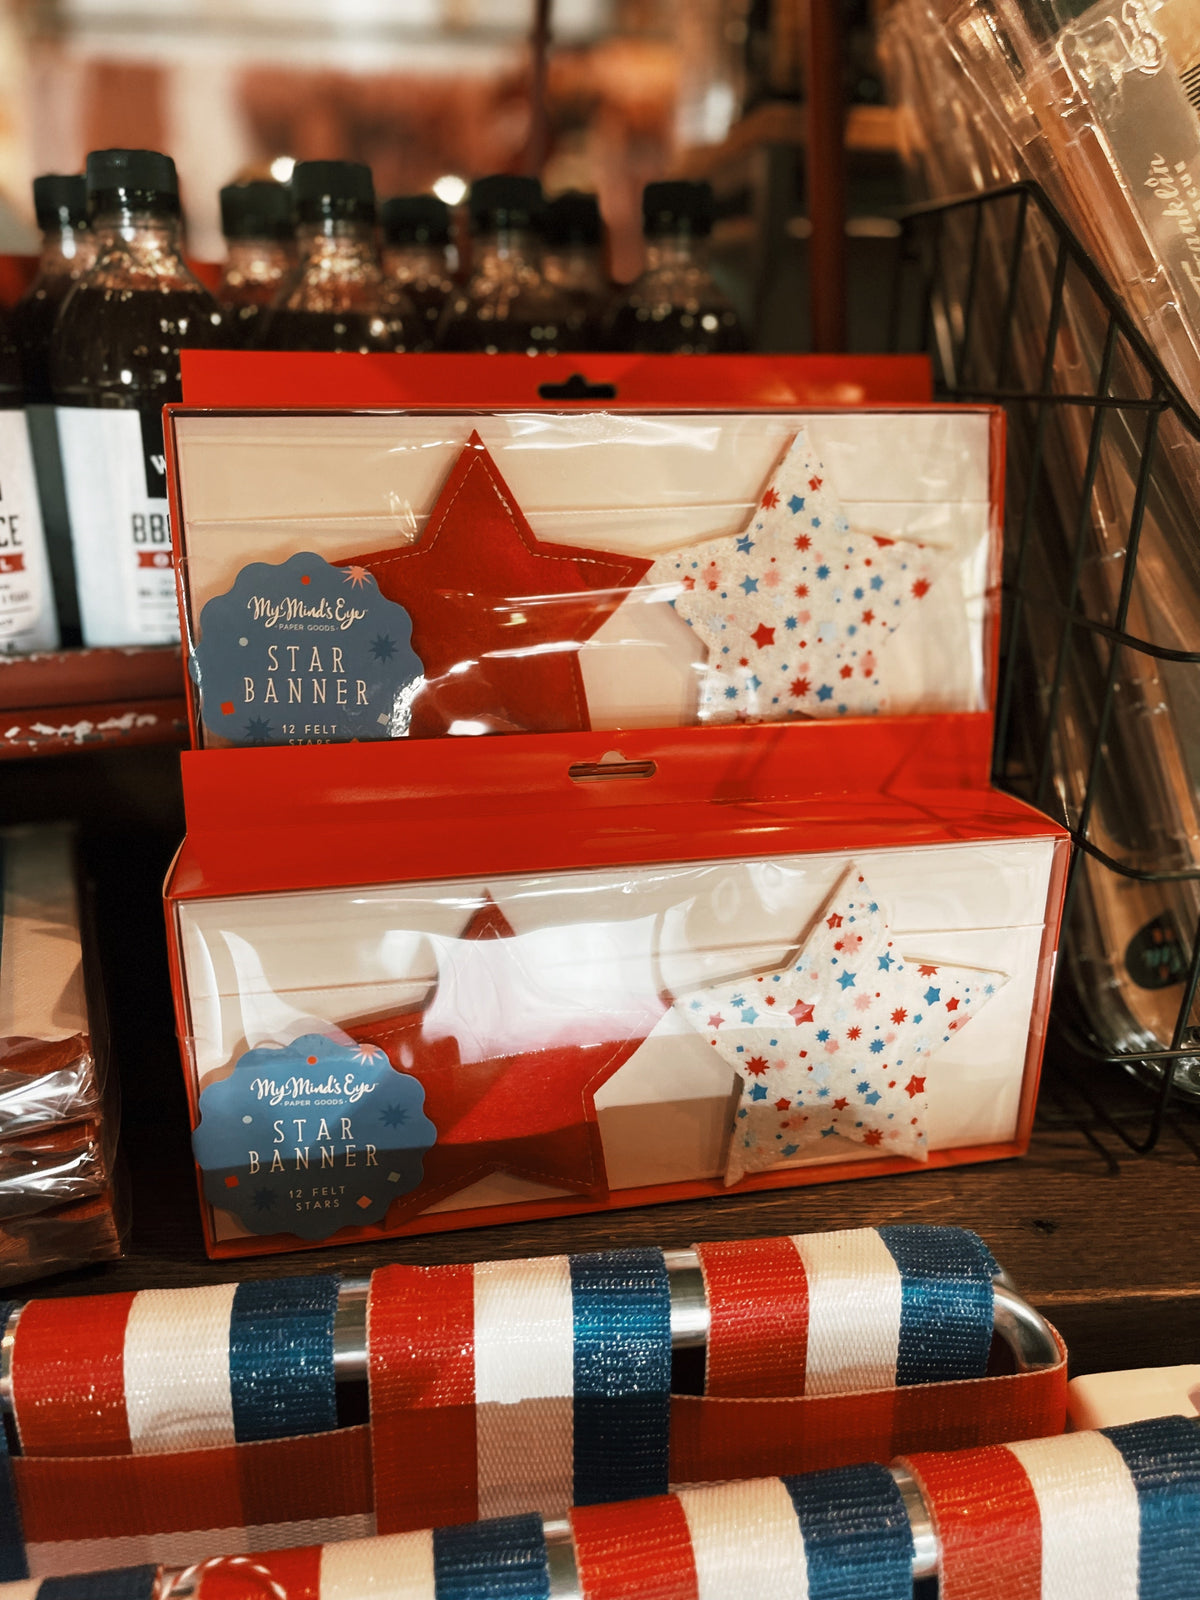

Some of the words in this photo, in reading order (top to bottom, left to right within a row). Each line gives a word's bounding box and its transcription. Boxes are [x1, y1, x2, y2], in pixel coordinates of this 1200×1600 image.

[132, 513, 172, 543] BB
[247, 596, 284, 628] My
[281, 597, 334, 621] Mind's
[335, 597, 367, 630] Eye
[279, 623, 304, 631] PAPER
[267, 645, 346, 673] STAR
[243, 676, 369, 705] BANNER
[282, 724, 296, 734] 12
[304, 724, 337, 734] FELT
[250, 1078, 287, 1106] My
[286, 1076, 342, 1098] Mind's
[343, 1073, 376, 1103] Eye
[314, 1098, 344, 1106] GOODS
[273, 1117, 354, 1144] STAR
[248, 1144, 379, 1175] BANNER
[288, 1190, 303, 1199] 12
[312, 1185, 346, 1197] FELT
[295, 1199, 341, 1212] STARS
